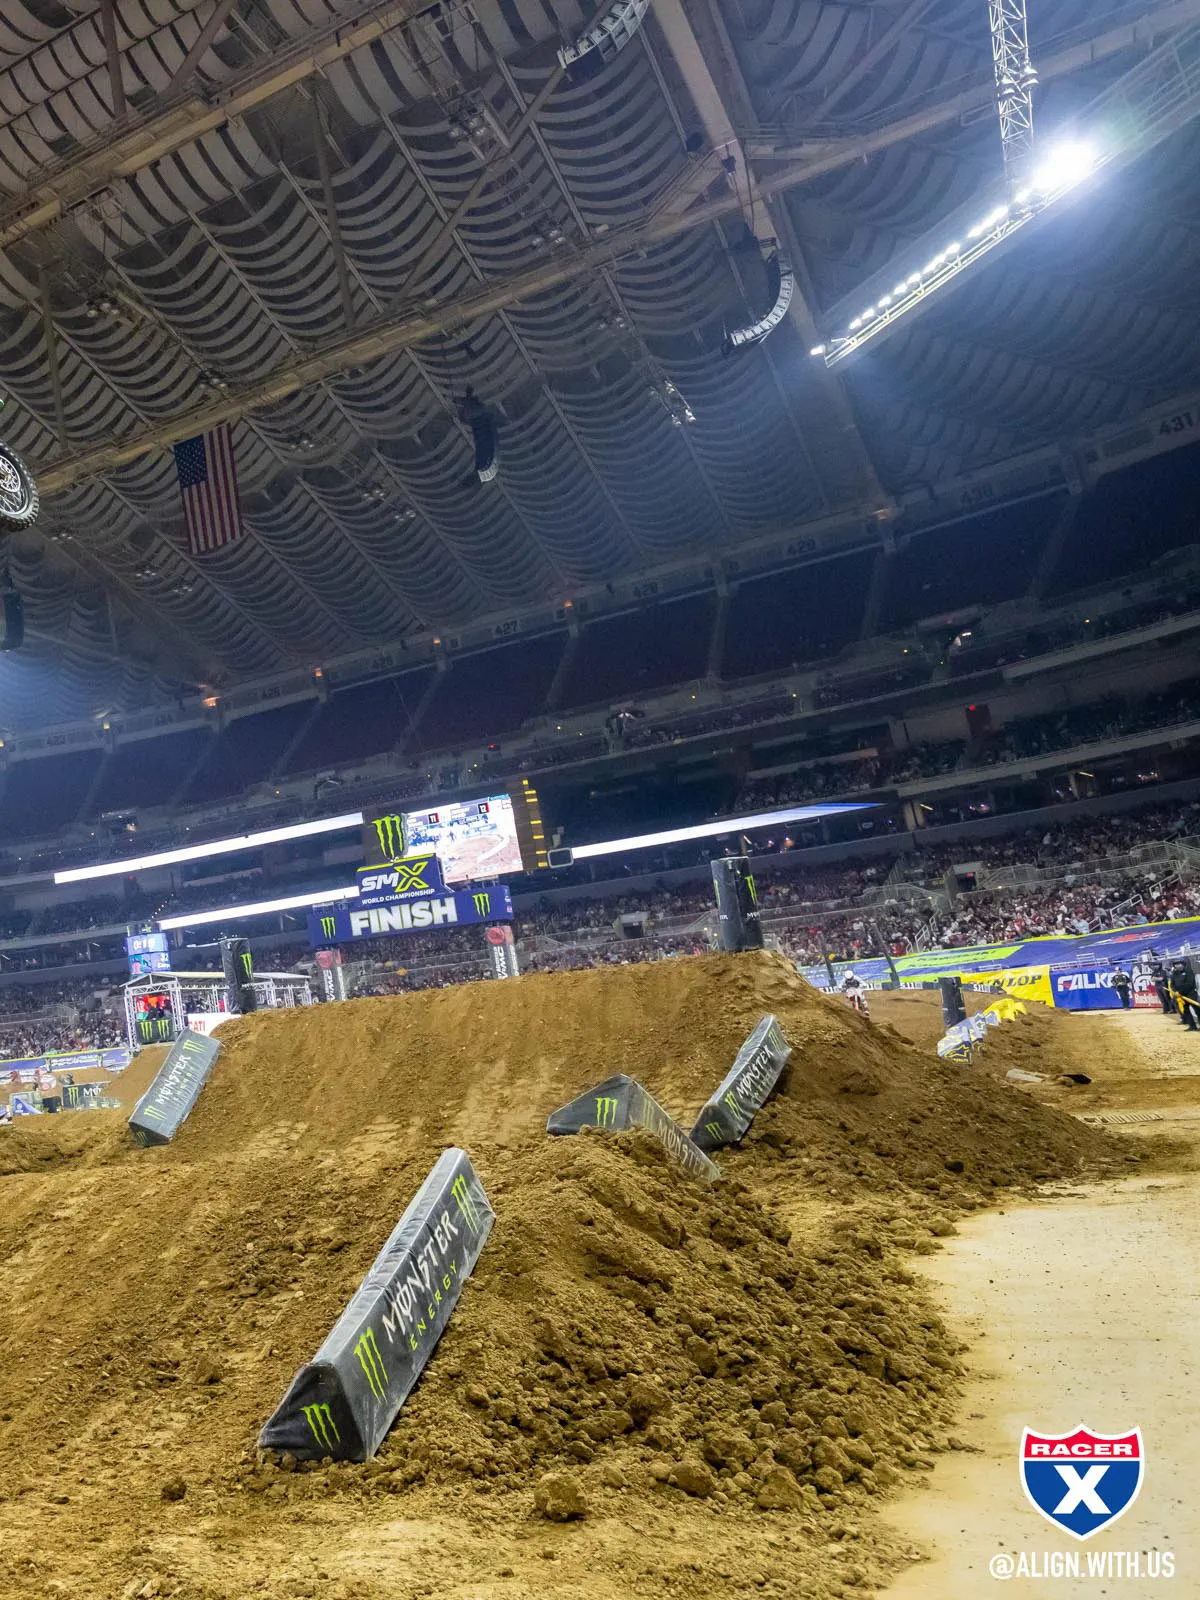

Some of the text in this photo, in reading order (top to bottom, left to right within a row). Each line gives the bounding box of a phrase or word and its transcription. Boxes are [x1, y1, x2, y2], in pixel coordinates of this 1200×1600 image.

[1159, 411, 1194, 435] 431
[494, 620, 518, 636] 427
[360, 861, 430, 893] SMX
[362, 888, 436, 905] WORLD CHAMPIONSHIP
[350, 896, 458, 937] FINISH
[971, 975, 1042, 988] NLOP
[1058, 971, 1130, 992] FALK
[155, 1054, 192, 1105] MONSTER
[736, 1045, 774, 1100] MONSTER
[381, 1209, 460, 1344] MONSTER
[409, 1259, 458, 1351] ENERGY
